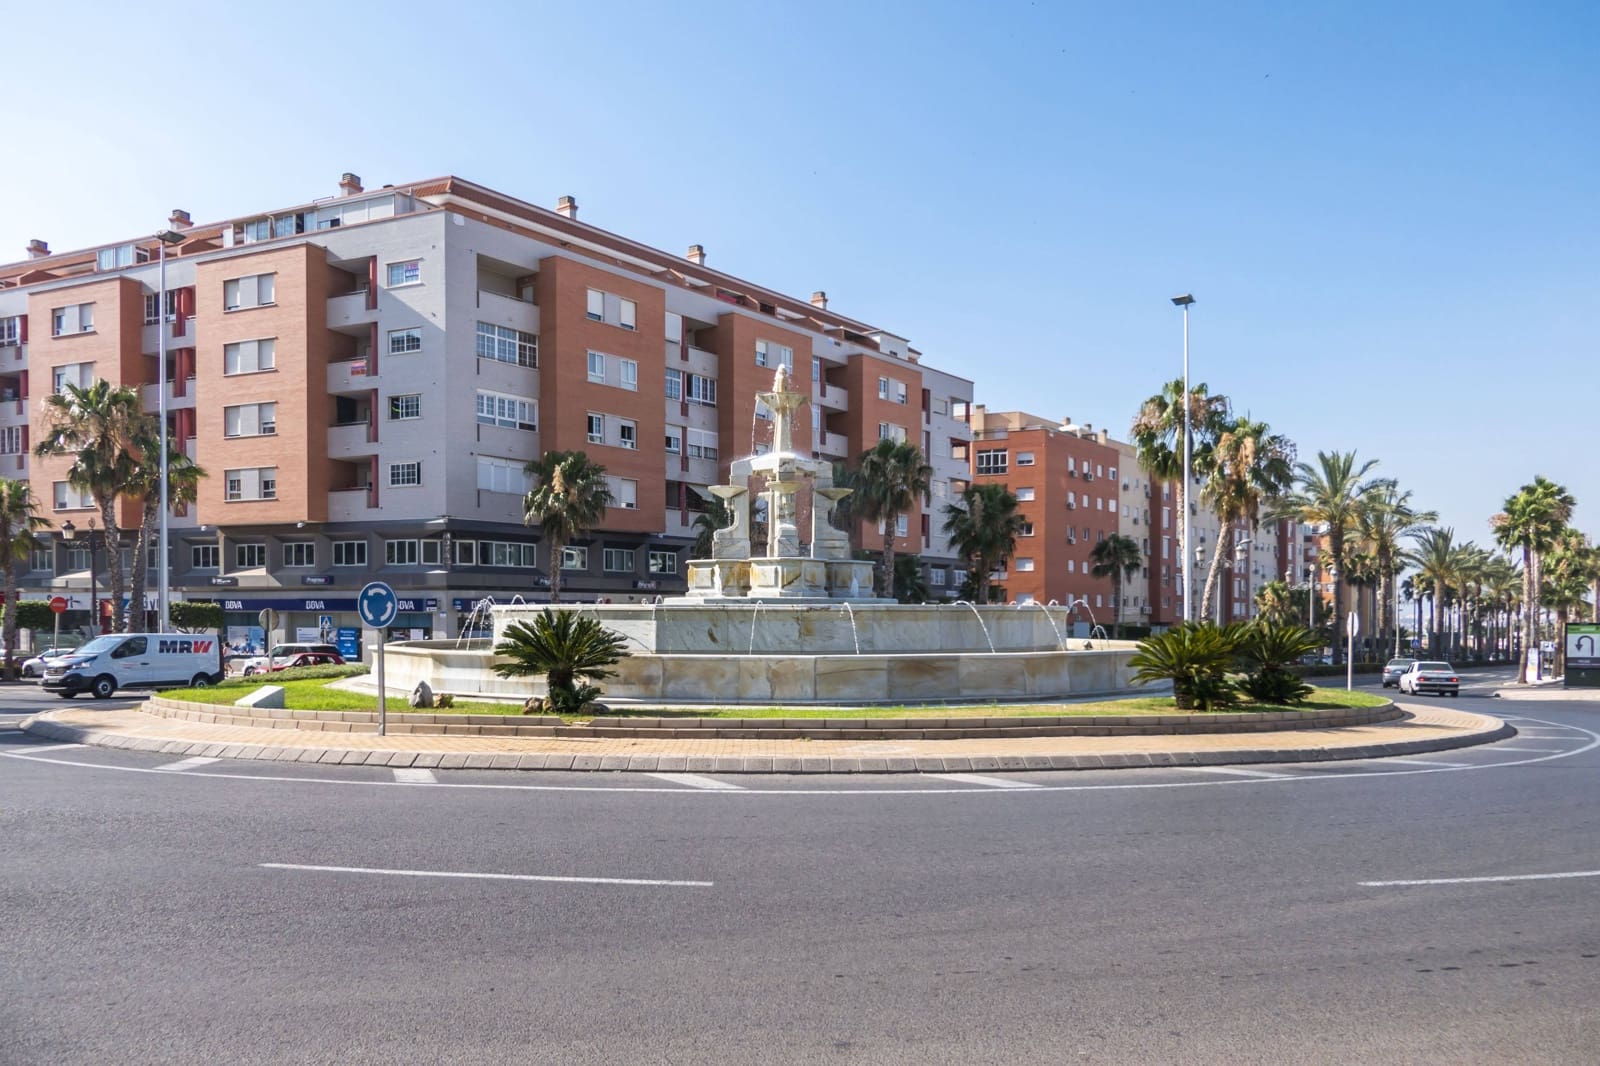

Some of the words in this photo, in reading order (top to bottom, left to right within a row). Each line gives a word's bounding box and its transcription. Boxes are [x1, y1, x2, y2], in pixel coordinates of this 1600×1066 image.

[225, 600, 243, 610] BBVA
[305, 600, 325, 610] BBVA
[398, 600, 415, 610] BVA
[159, 640, 213, 654] MRW
